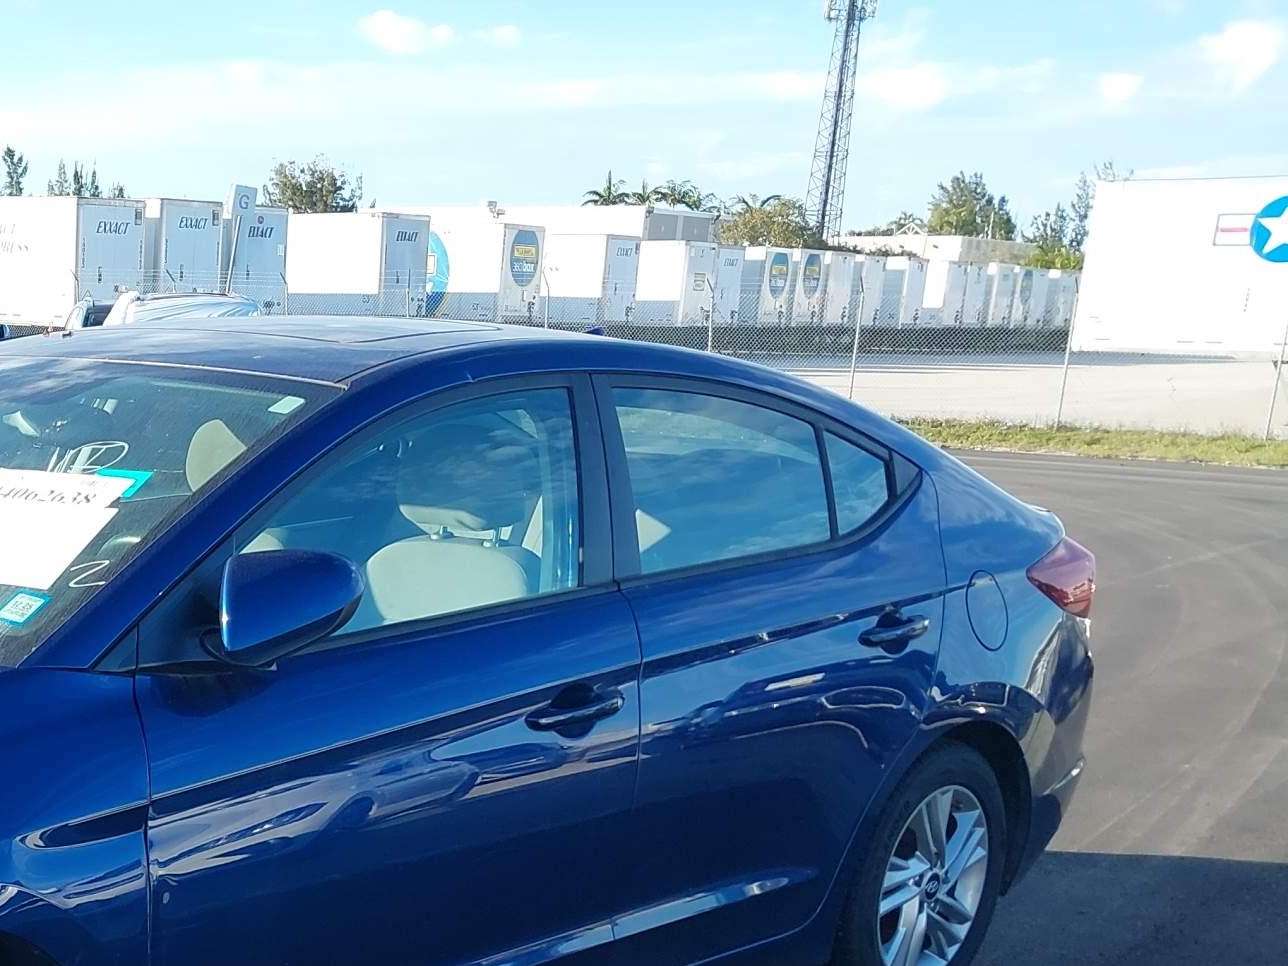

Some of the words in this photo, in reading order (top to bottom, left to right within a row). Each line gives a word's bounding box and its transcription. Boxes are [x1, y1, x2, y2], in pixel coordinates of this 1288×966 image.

[238, 194, 250, 209] G
[96, 220, 131, 235] EXXACT
[178, 216, 208, 230] EXXACT
